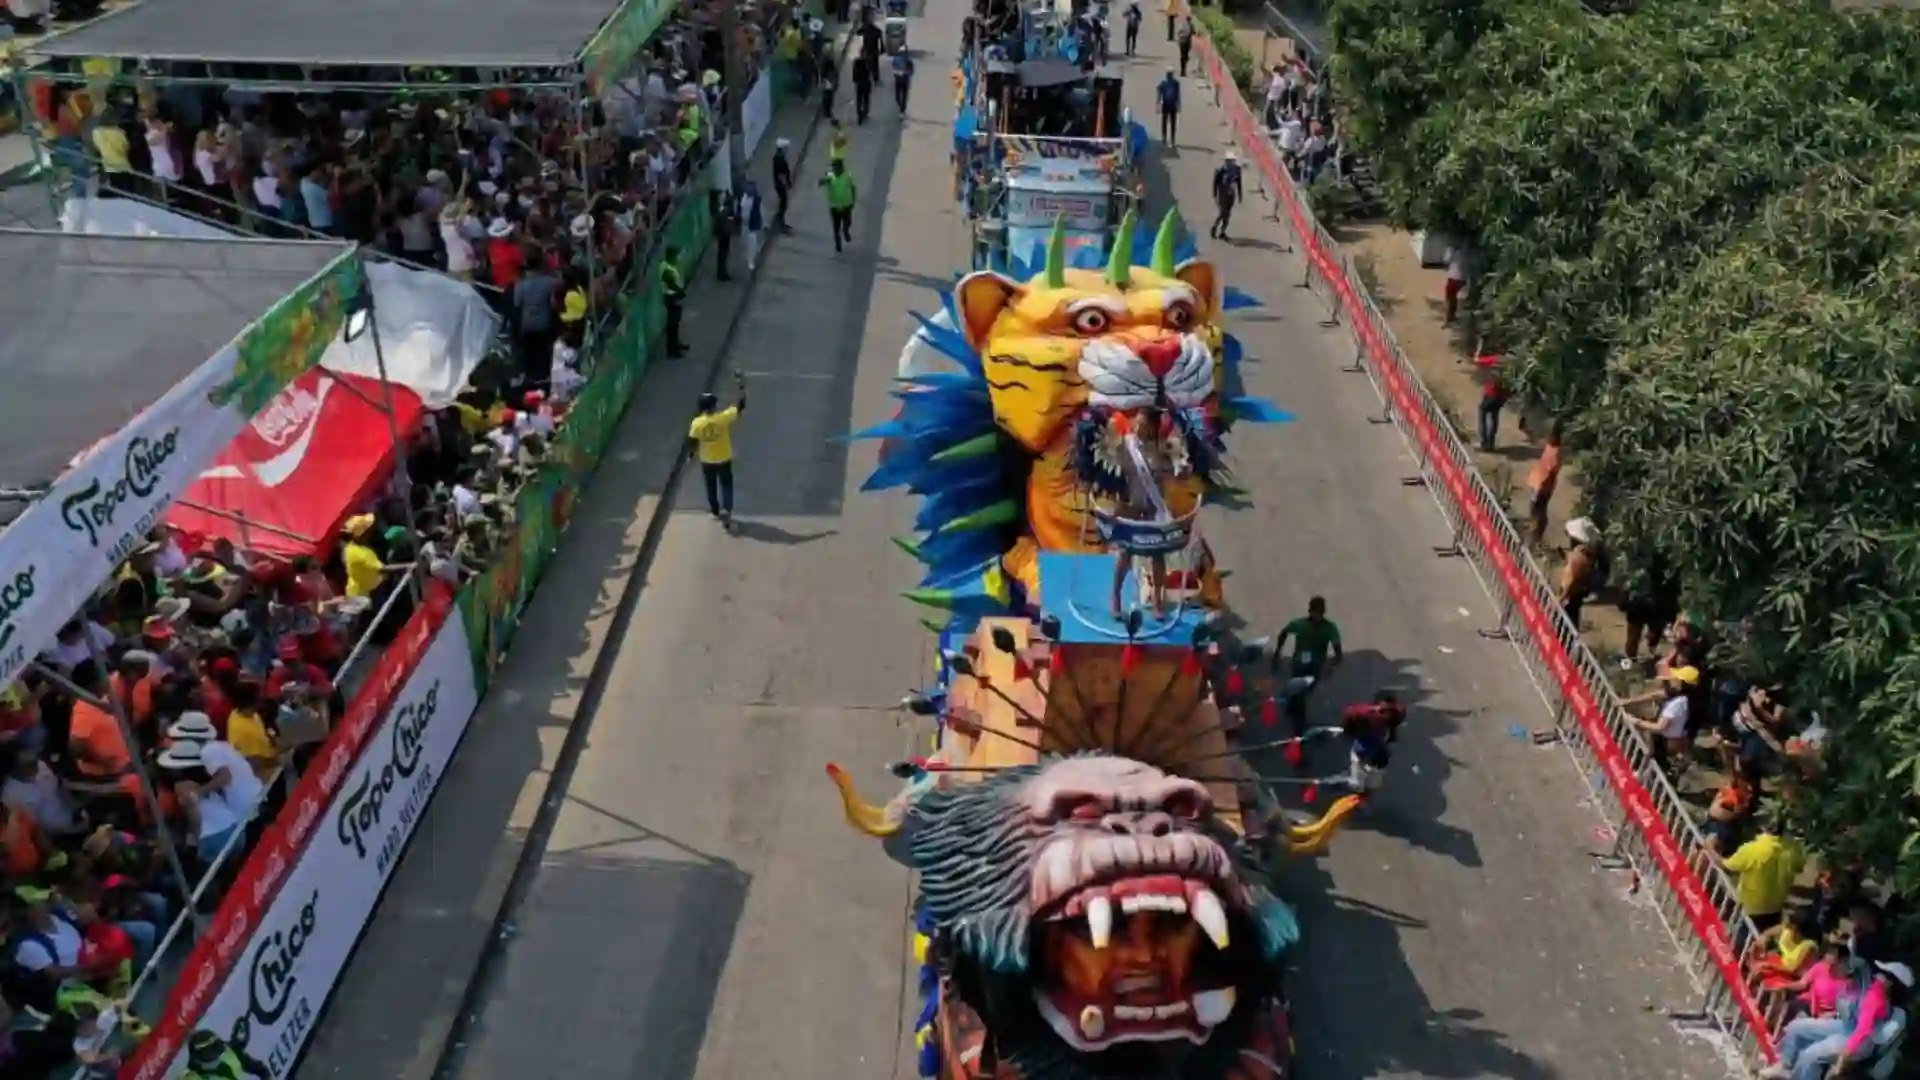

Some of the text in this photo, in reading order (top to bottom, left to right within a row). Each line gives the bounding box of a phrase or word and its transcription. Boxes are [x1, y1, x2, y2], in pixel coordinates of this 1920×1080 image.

[61, 476, 128, 547] Topo
[126, 427, 180, 497] Chico
[338, 764, 394, 859] Topo
[393, 679, 440, 778] Chico
[247, 890, 319, 1025] Chico
[268, 996, 312, 1078] ELTZER
